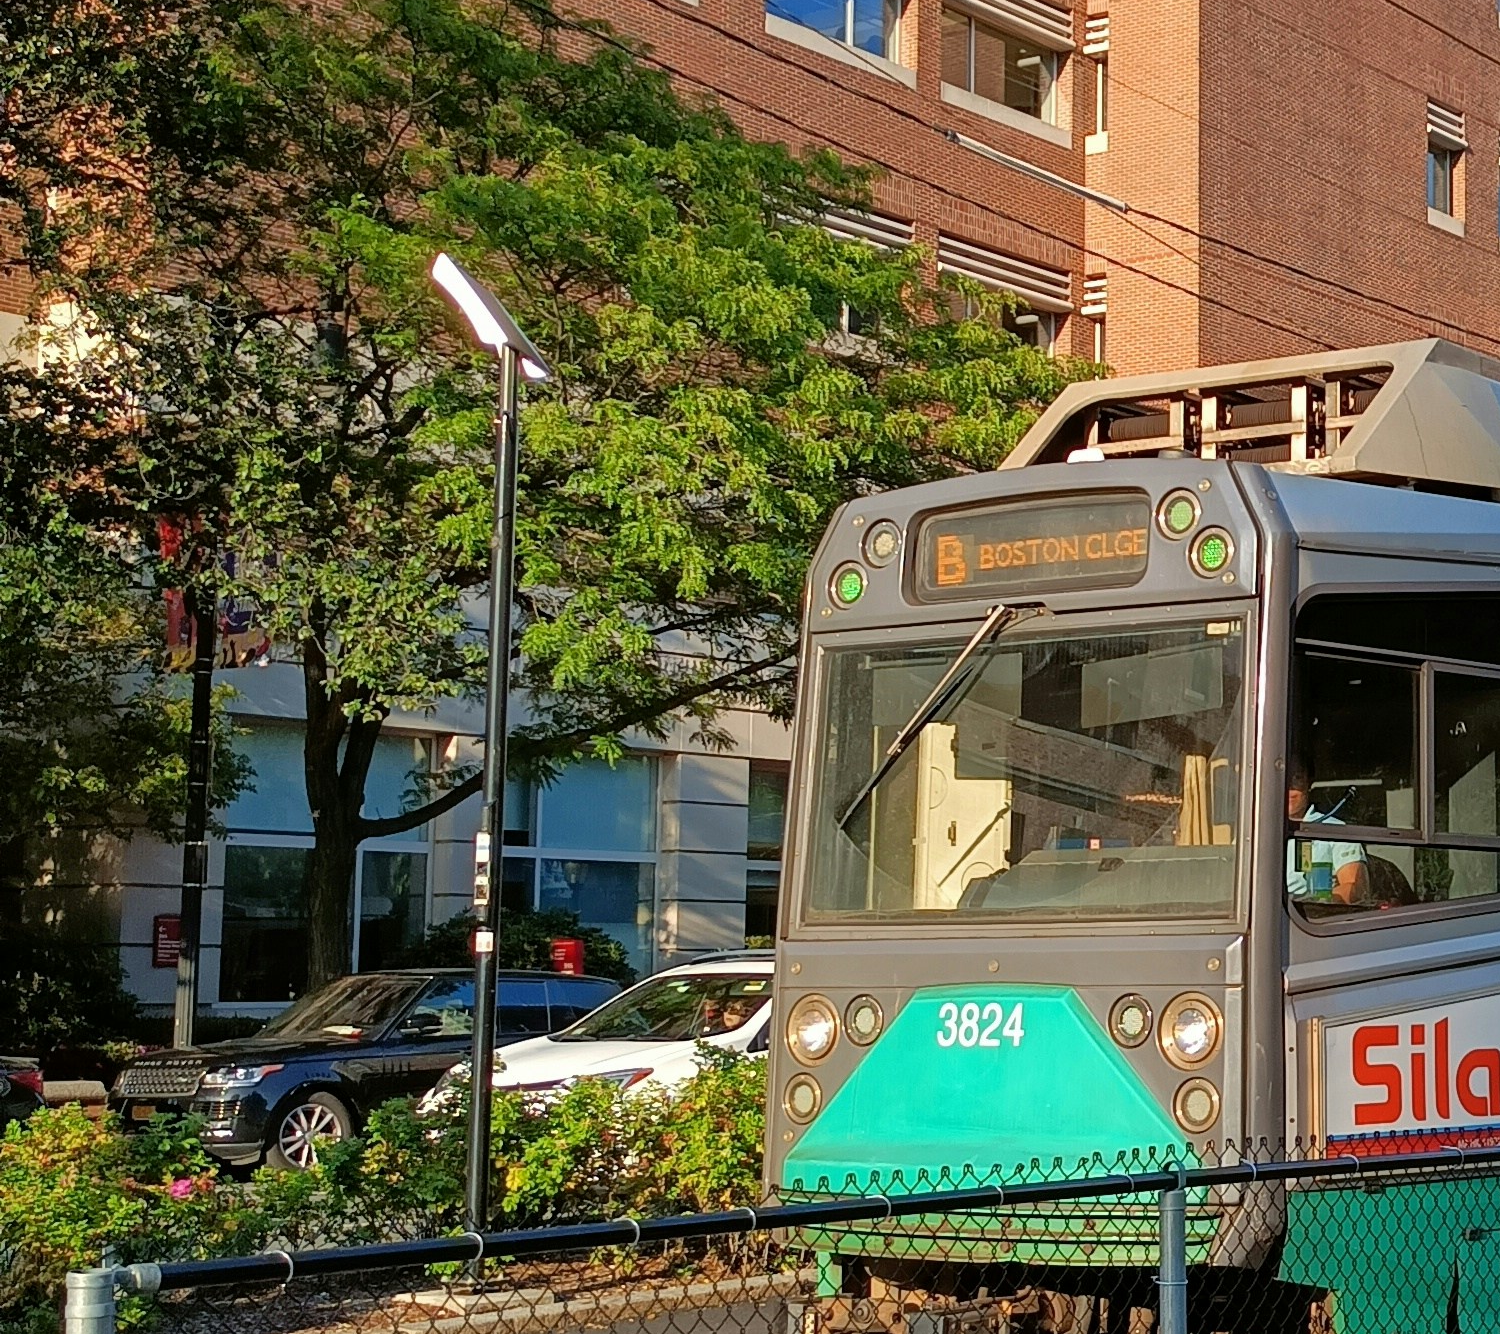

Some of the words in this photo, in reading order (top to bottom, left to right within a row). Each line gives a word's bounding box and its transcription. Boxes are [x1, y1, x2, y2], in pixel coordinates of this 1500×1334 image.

[936, 534, 967, 585] B
[979, 535, 1079, 570] BOSTON
[1083, 527, 1147, 557] CLGE
[937, 1002, 1024, 1047] 3824
